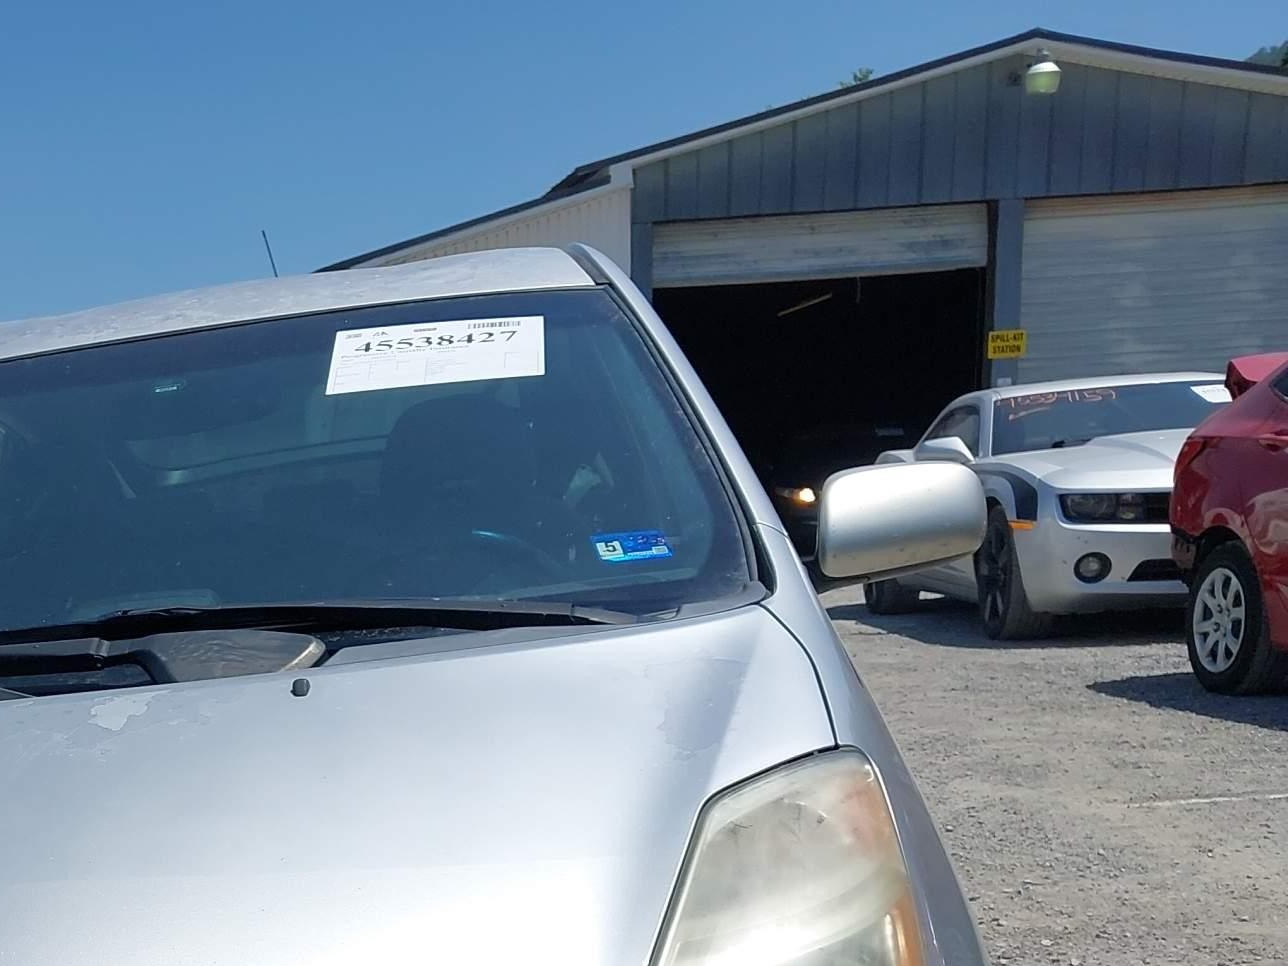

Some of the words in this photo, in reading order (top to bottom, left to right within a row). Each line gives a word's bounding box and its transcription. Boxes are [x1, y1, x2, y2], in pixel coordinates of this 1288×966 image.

[354, 330, 518, 353] 45538427
[990, 332, 1024, 343] SPILL-KIT
[992, 343, 1022, 354] STATION
